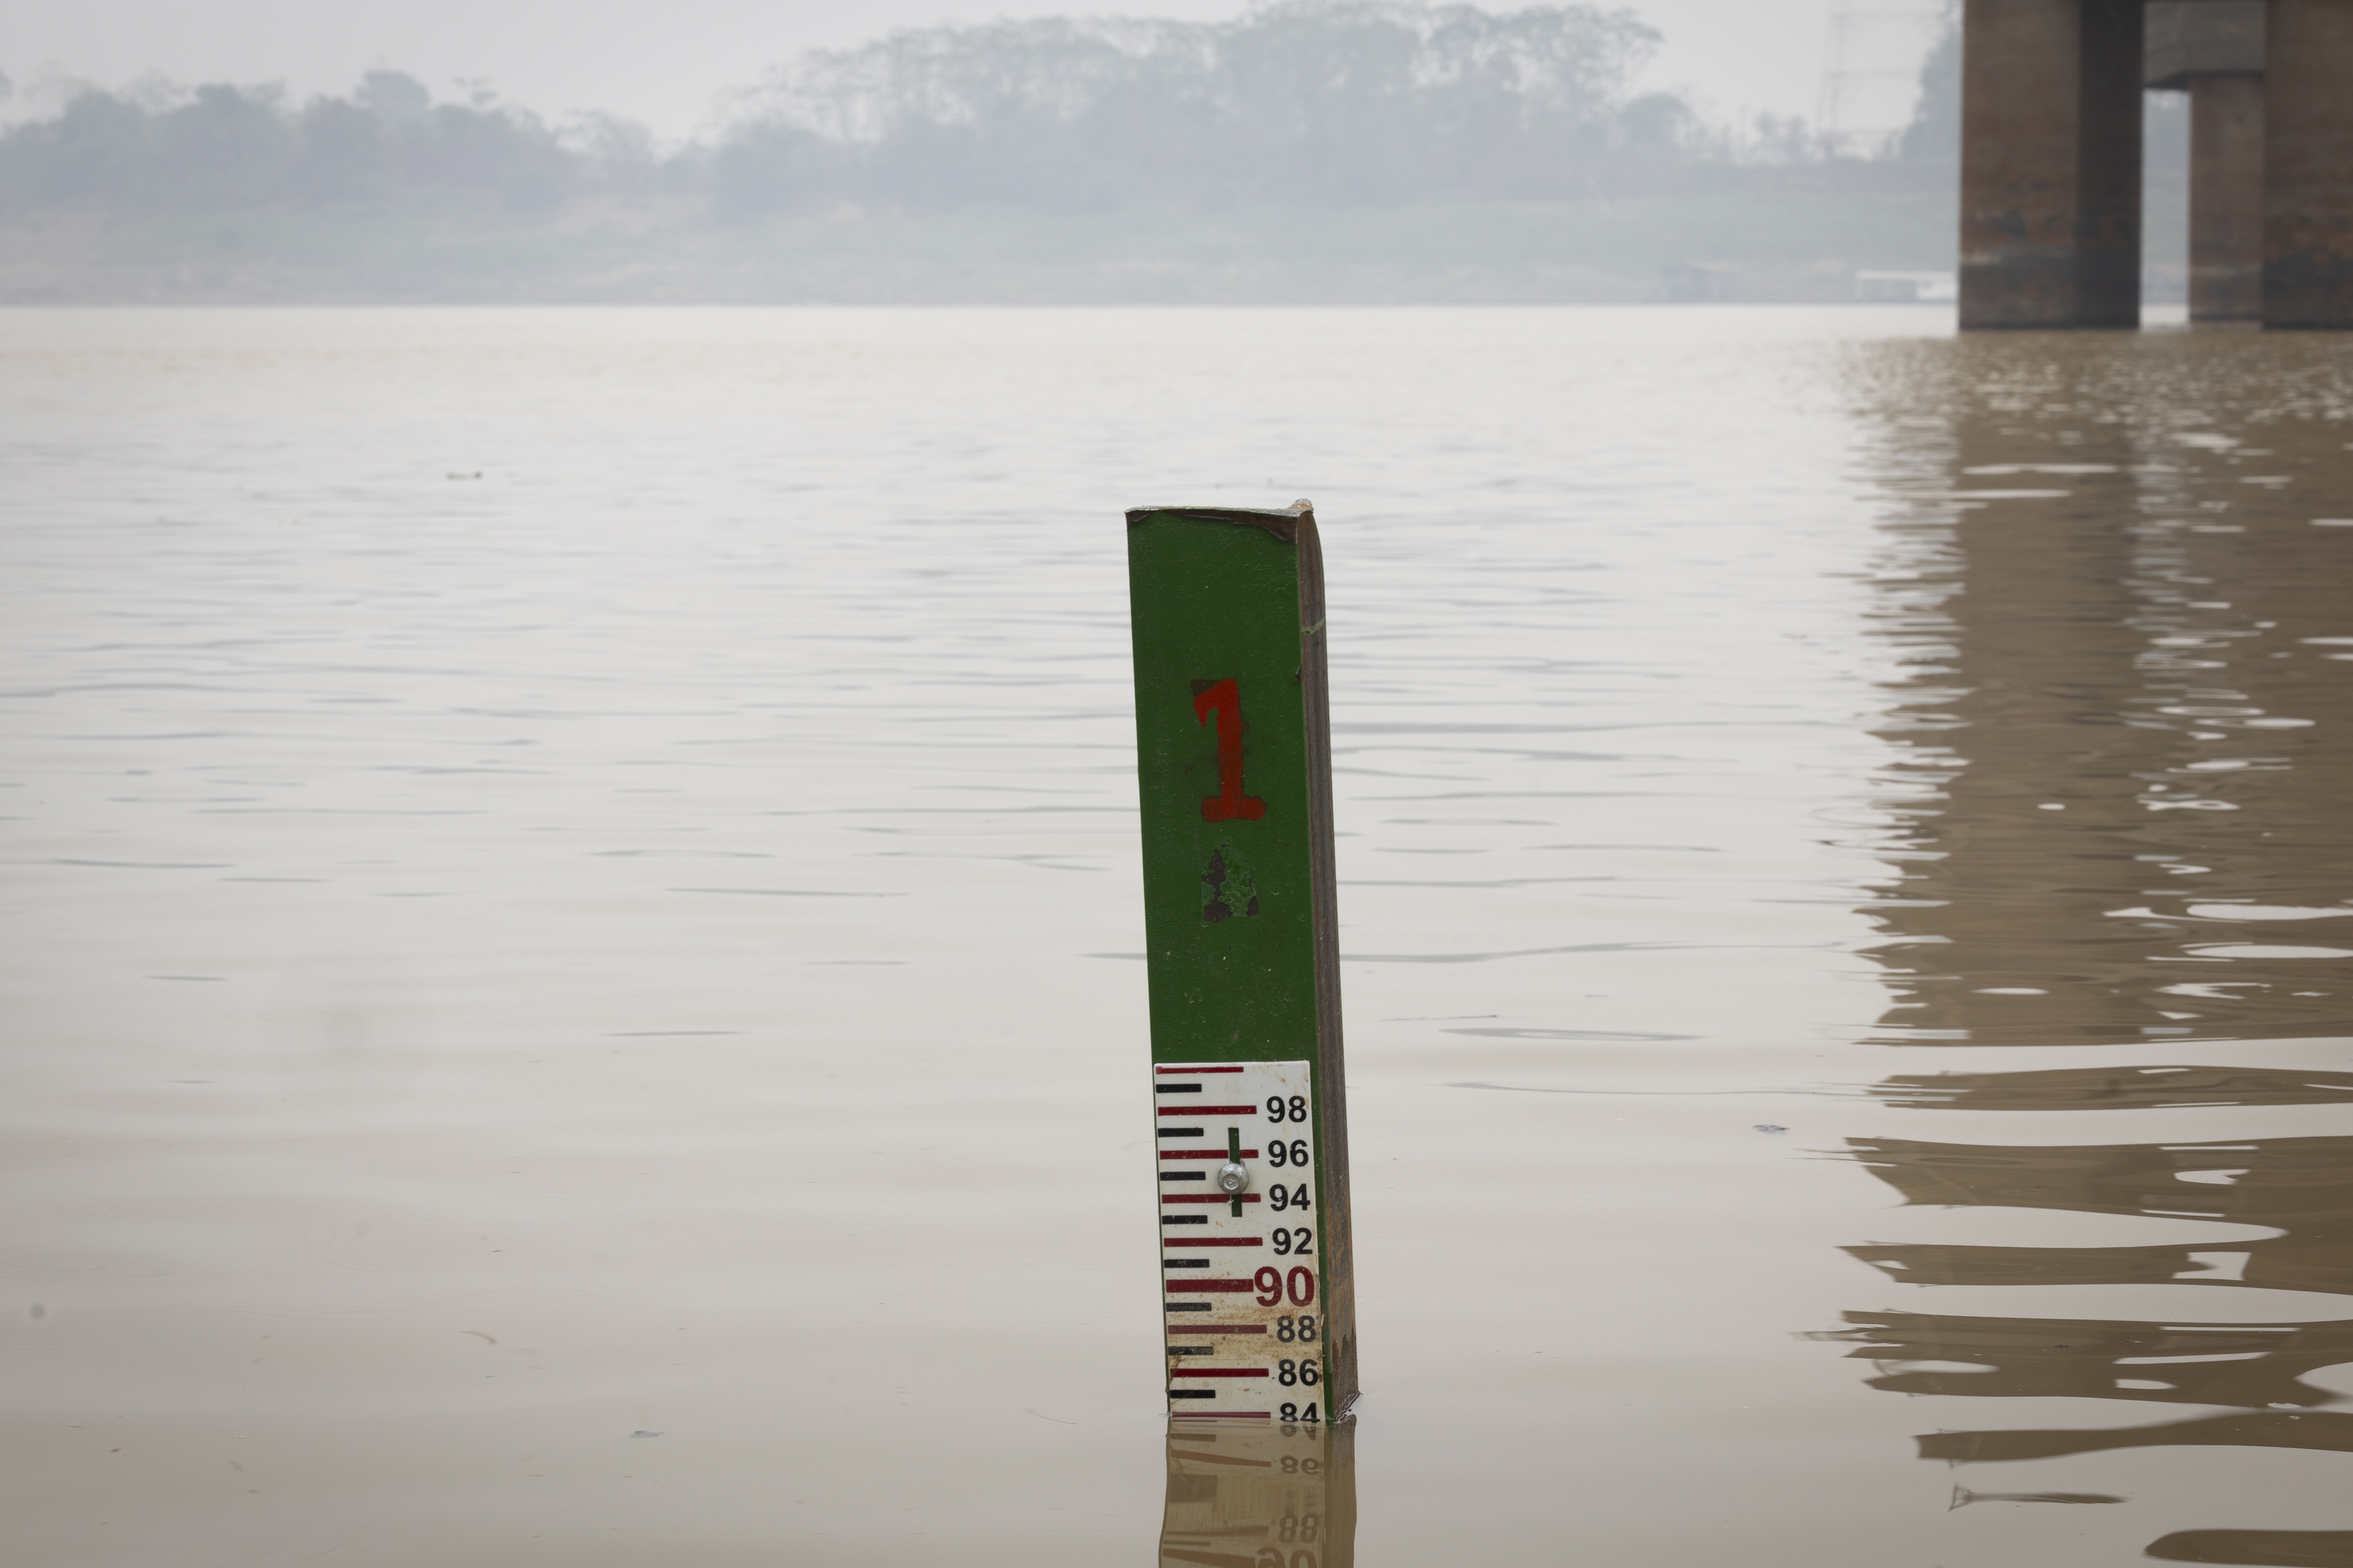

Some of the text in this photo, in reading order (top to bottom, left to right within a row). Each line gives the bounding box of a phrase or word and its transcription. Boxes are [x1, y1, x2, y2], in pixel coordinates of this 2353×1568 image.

[1194, 679, 1268, 822] 1
[1266, 1096, 1307, 1123] 98
[1268, 1140, 1309, 1168] 96
[1269, 1184, 1311, 1211] 94
[1272, 1228, 1313, 1255] 92
[1254, 1266, 1315, 1307] 90
[1277, 1315, 1317, 1343] 88
[1279, 1359, 1319, 1386] 86
[1279, 1402, 1320, 1424] 84
